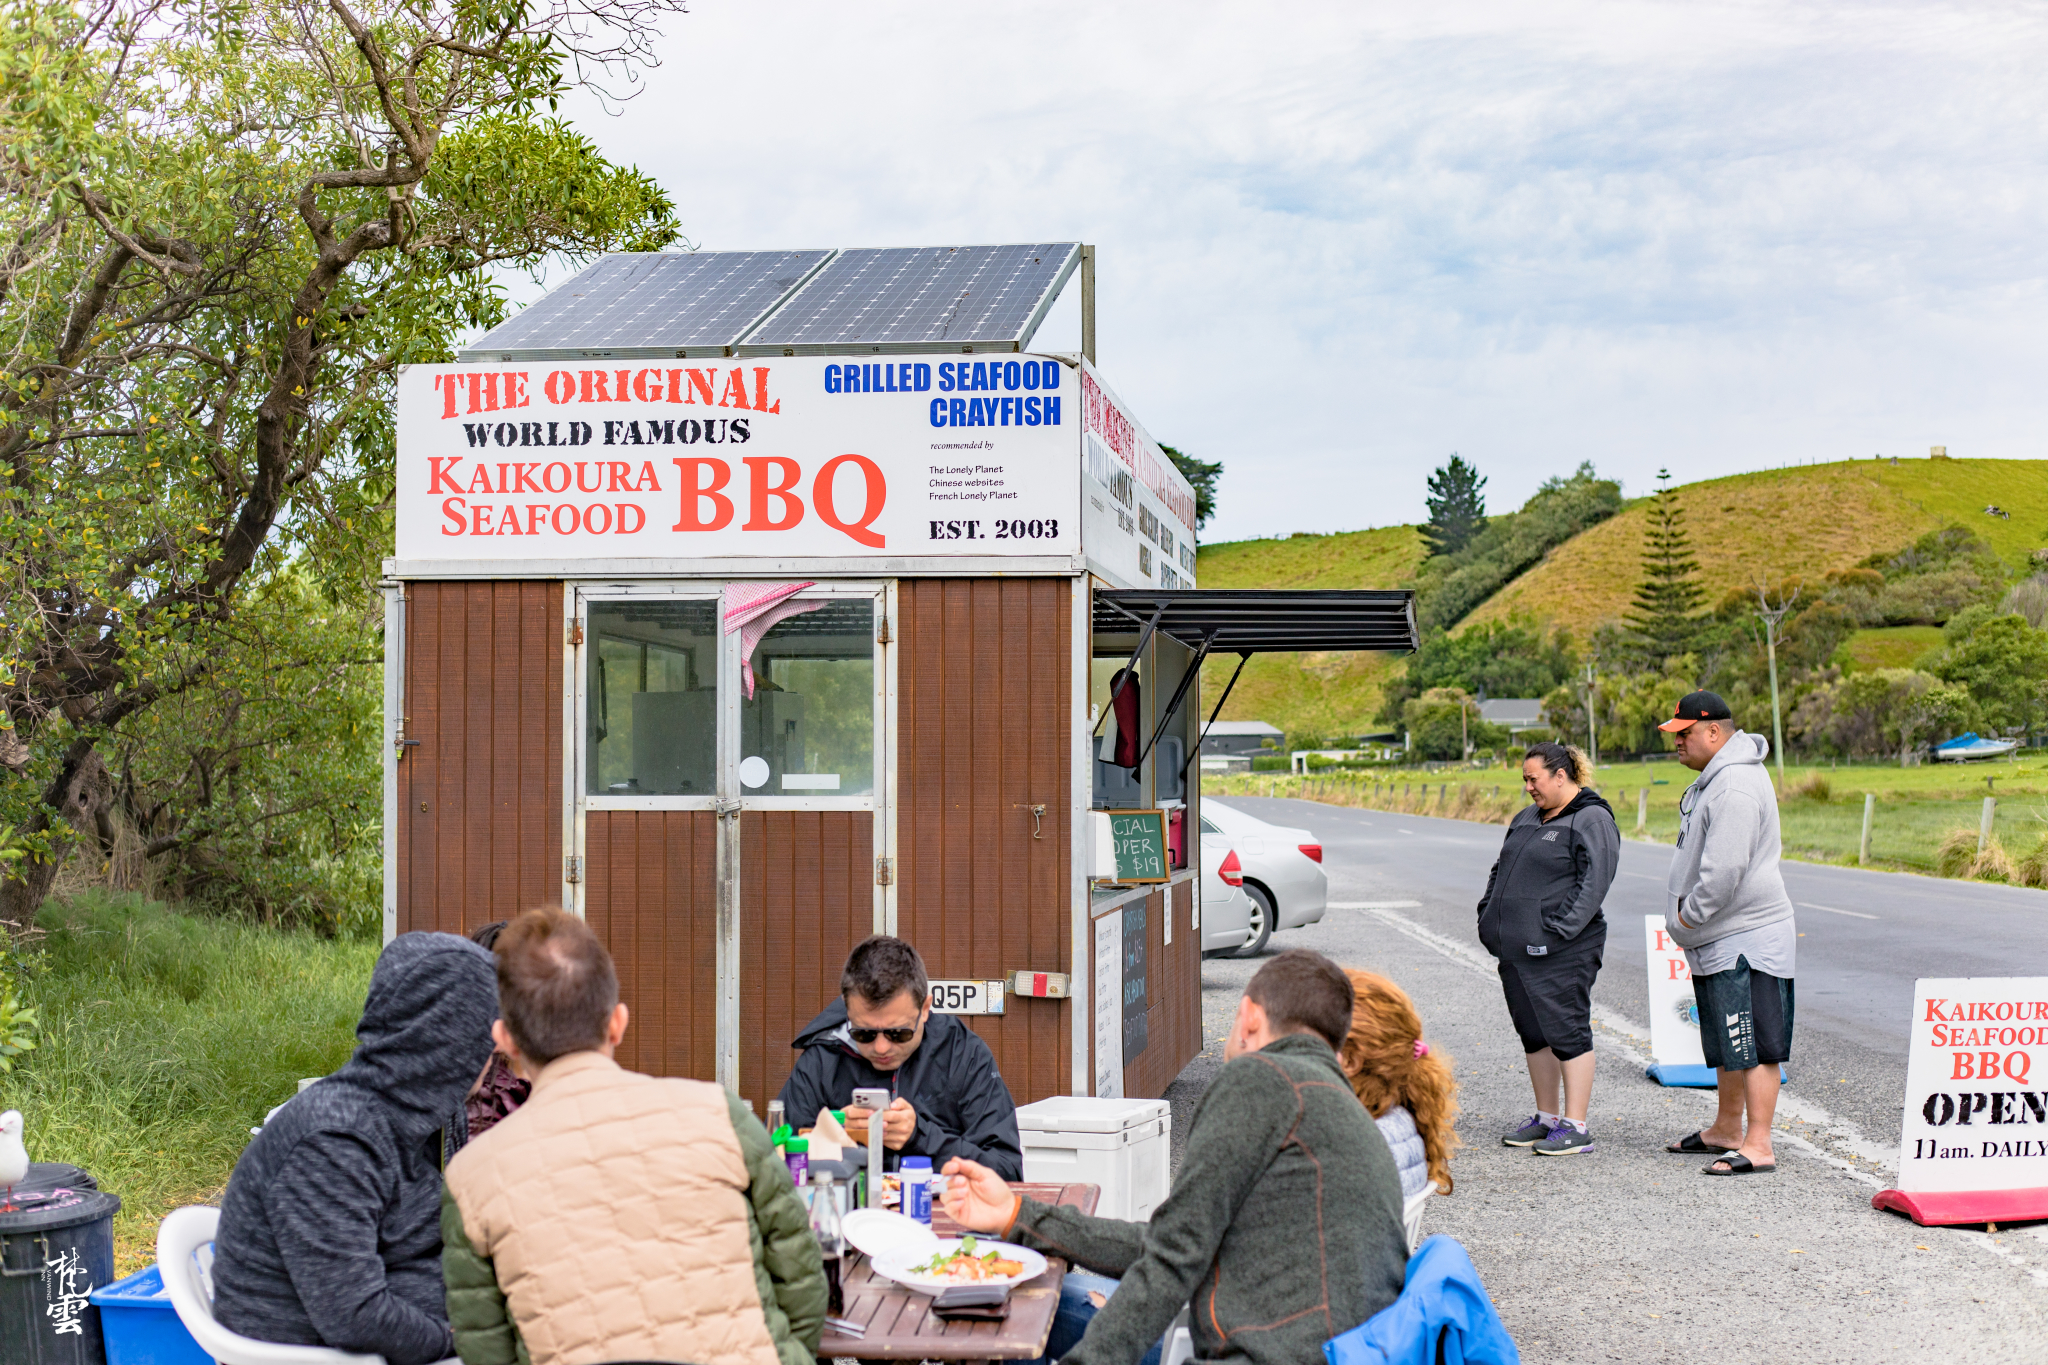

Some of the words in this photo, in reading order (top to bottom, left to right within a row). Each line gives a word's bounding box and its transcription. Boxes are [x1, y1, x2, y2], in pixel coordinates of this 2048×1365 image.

[824, 363, 931, 394] GRILLED
[938, 361, 1060, 391] SEAFOOD
[434, 371, 530, 420] THE
[543, 366, 781, 415] ORIGINAL
[929, 396, 1061, 427] CRAYFISH
[462, 421, 593, 448] WORLD
[602, 418, 751, 446] FAMOUS
[930, 441, 983, 450] recommended
[985, 441, 994, 451] by
[426, 456, 663, 494] KAIKOURA
[929, 465, 945, 475] The
[946, 465, 974, 476] Lonely
[975, 465, 1004, 474] Planet
[929, 479, 963, 488] Chinese
[964, 478, 1005, 487] websites
[671, 454, 887, 549] BBQ
[929, 492, 959, 501] French
[960, 491, 988, 502] Lonely
[989, 491, 1018, 500] Planet
[441, 497, 647, 537] SEAFOOD
[928, 520, 986, 540] EST.
[994, 519, 1059, 540] 2003
[1132, 855, 1160, 876] $19
[1949, 1050, 2031, 1085] BBQ
[1922, 1091, 2048, 1126] OPEN
[1980, 1140, 2048, 1158] DAILY
